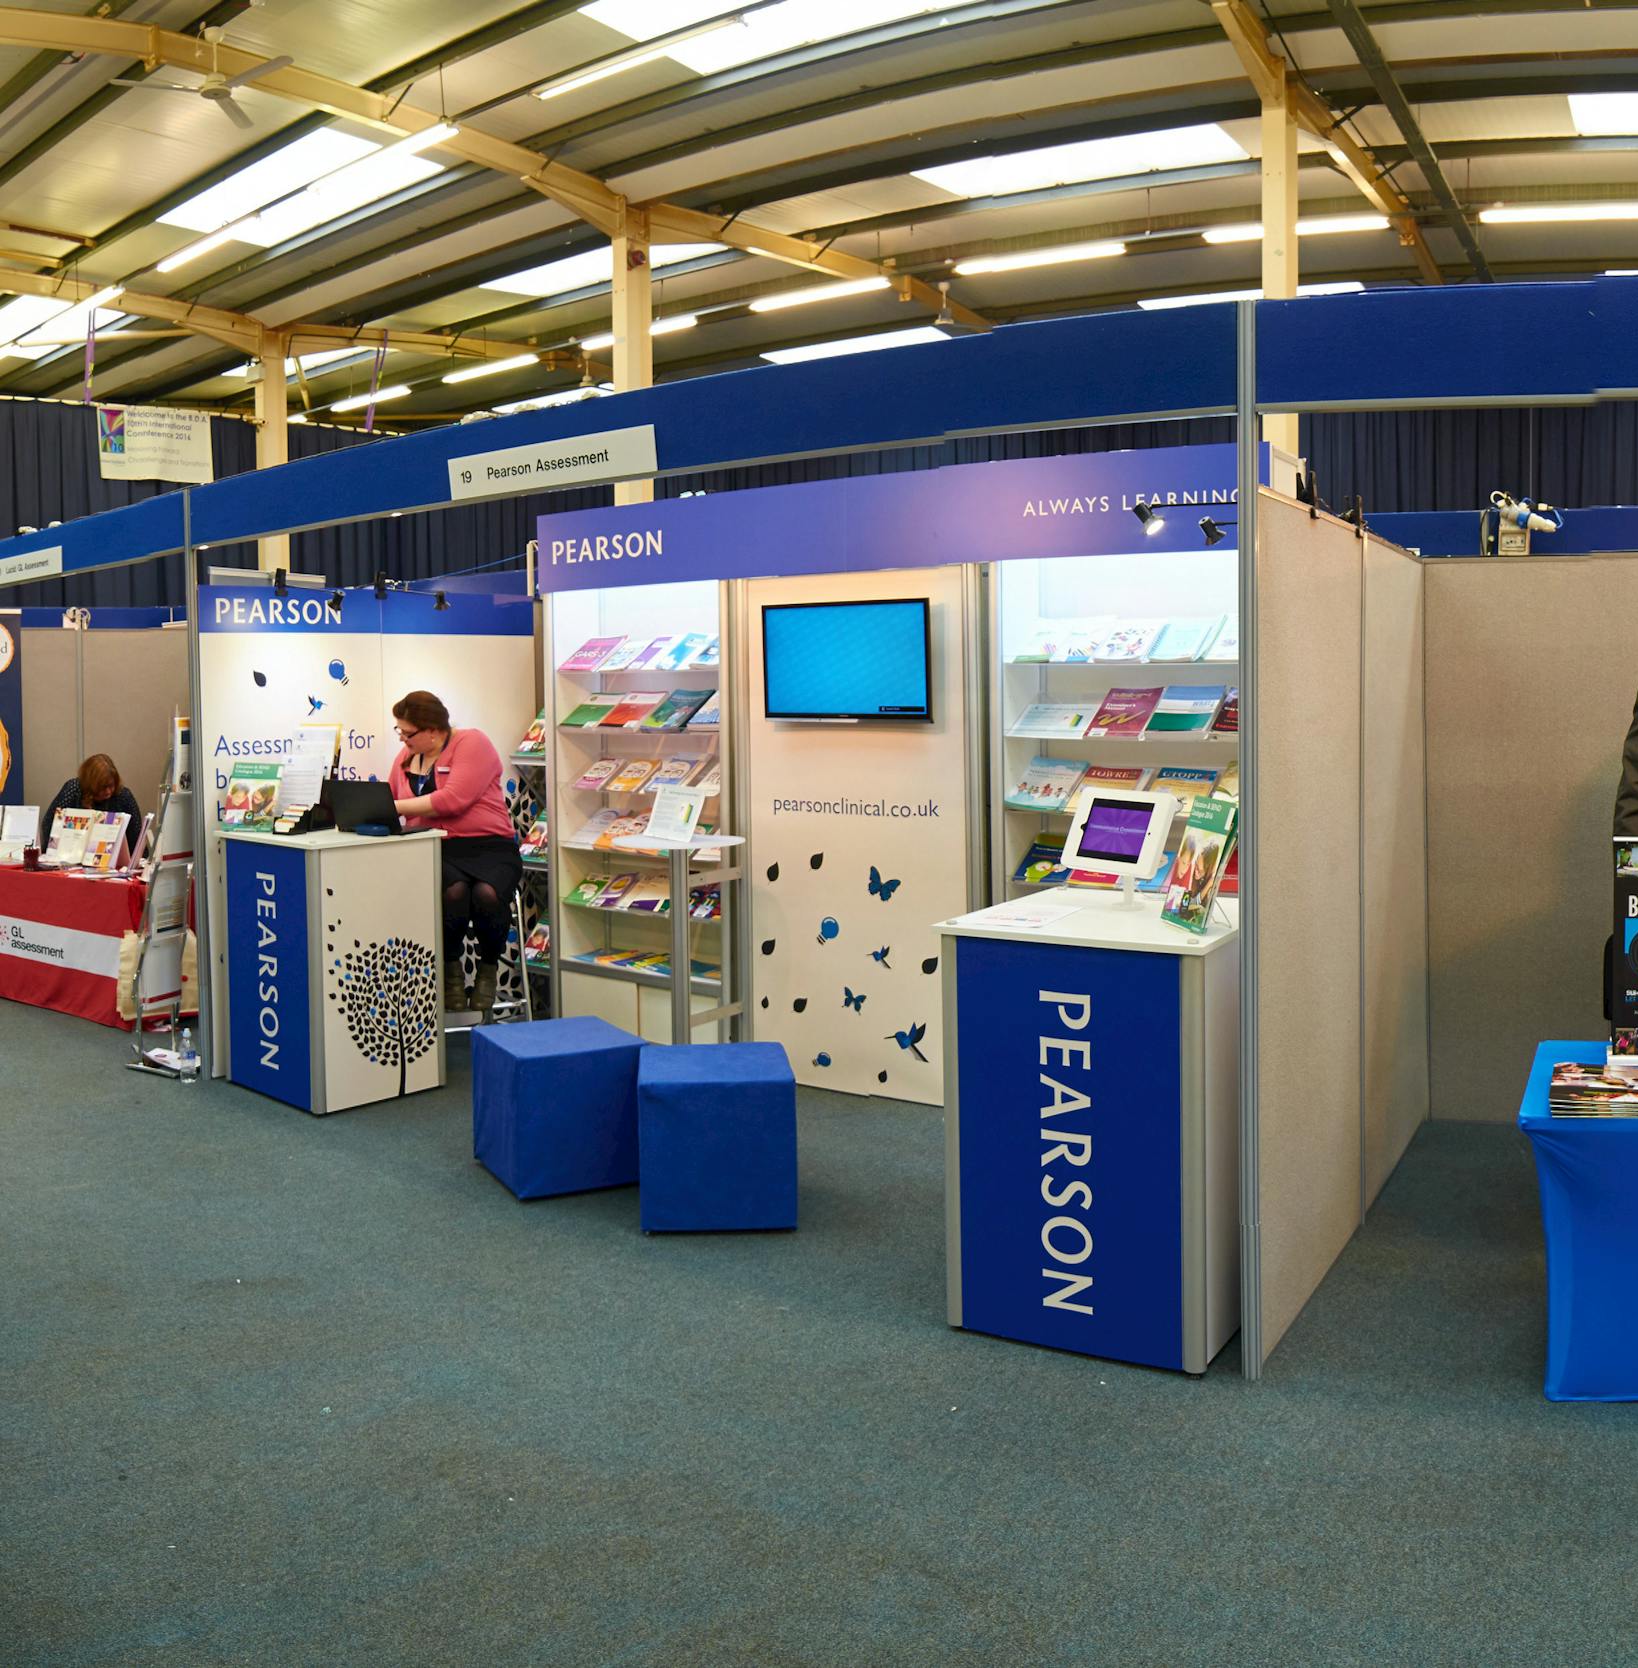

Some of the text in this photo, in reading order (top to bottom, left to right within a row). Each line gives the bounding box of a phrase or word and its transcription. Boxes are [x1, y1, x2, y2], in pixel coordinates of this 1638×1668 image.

[460, 448, 609, 483] 19 Pearson Assessment
[1022, 496, 1110, 517] ALWAYS
[552, 529, 663, 566] PEARSON
[215, 597, 342, 625] PEARSON
[773, 797, 940, 818] pearsonclinical.co.uk
[10, 938, 64, 960] assessment
[256, 871, 280, 1071] PEARSON
[1038, 989, 1094, 1316] PEARSON
